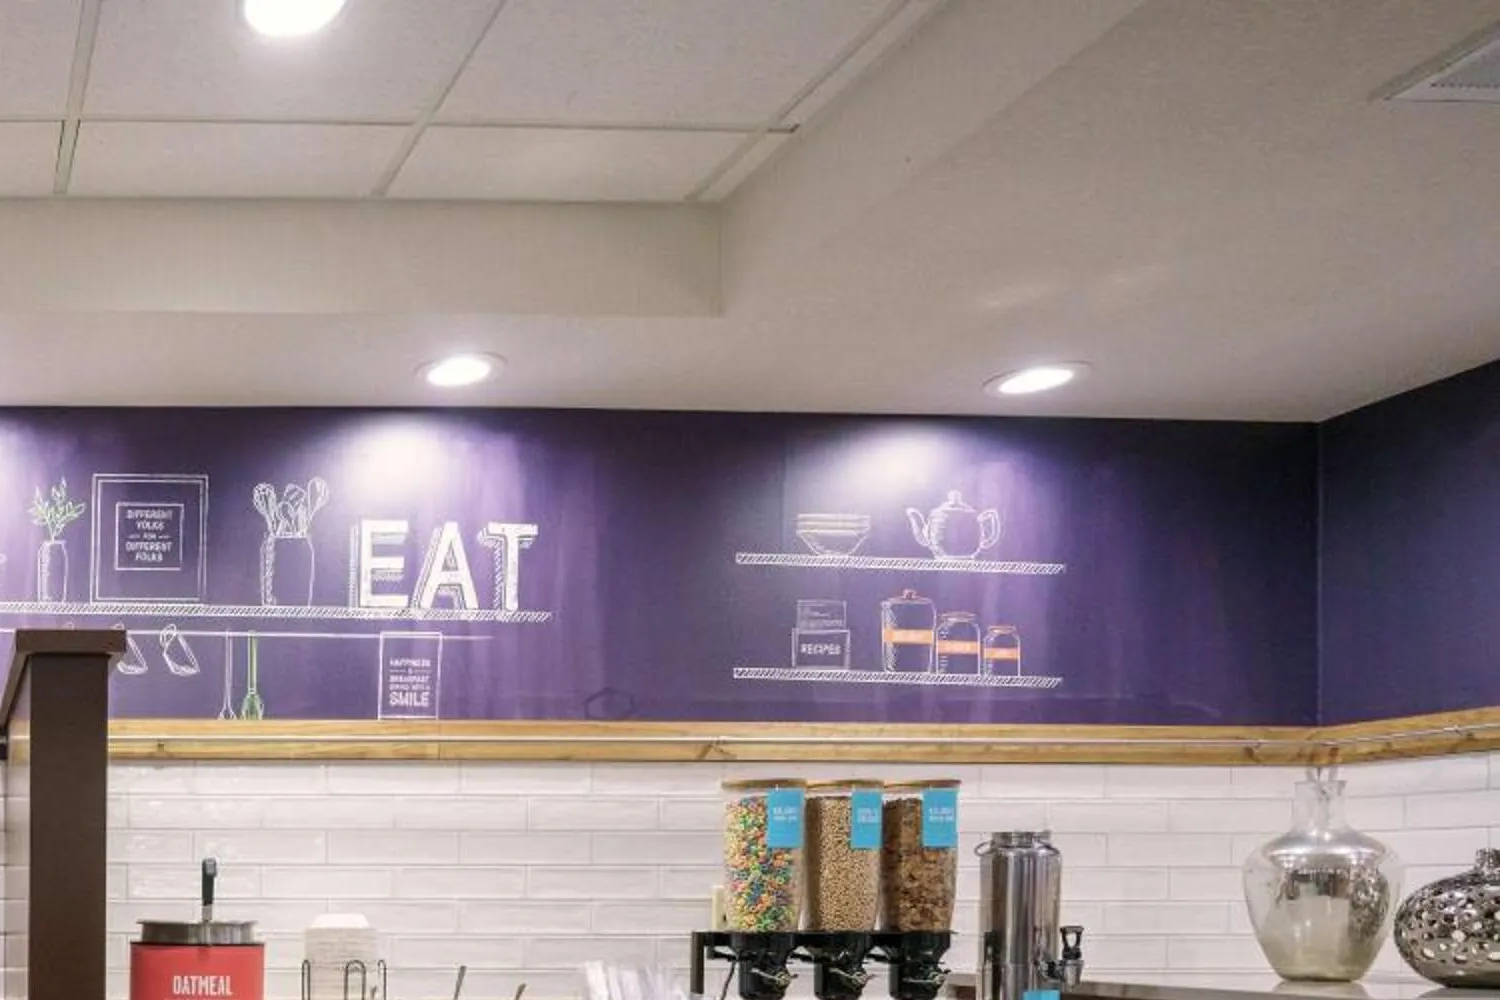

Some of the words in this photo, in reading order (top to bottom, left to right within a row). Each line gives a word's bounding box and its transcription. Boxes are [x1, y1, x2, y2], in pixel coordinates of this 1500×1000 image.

[350, 519, 539, 611] EAT
[389, 691, 430, 708] SMILE
[173, 975, 234, 996] OATMEAL
